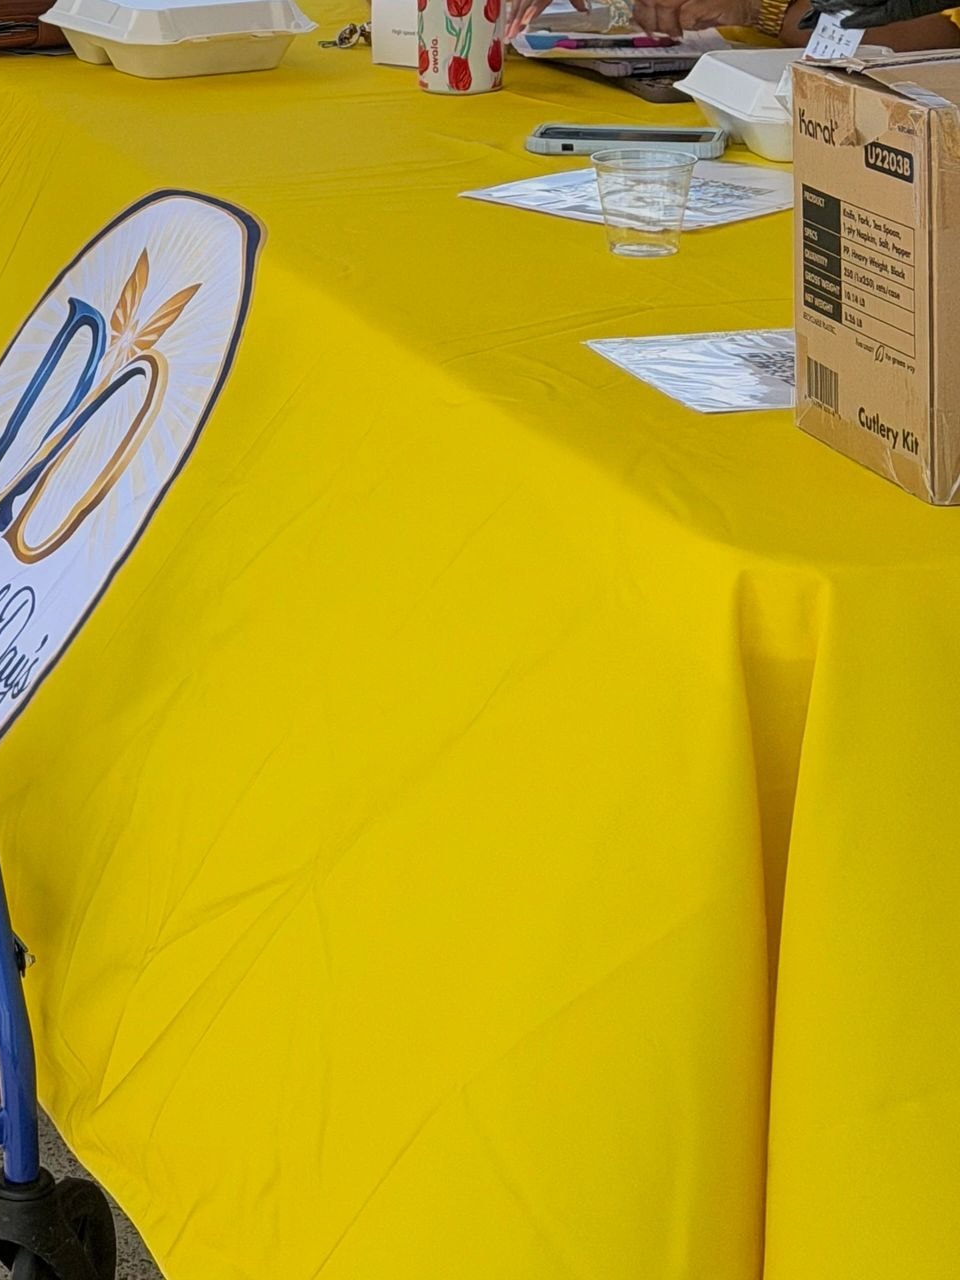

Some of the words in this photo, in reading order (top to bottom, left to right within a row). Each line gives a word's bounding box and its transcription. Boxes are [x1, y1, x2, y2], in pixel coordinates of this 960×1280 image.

[431, 38, 439, 74] owala
[867, 144, 911, 177] U2203B
[858, 406, 899, 450] Cutlery
[902, 428, 920, 456] Kit
